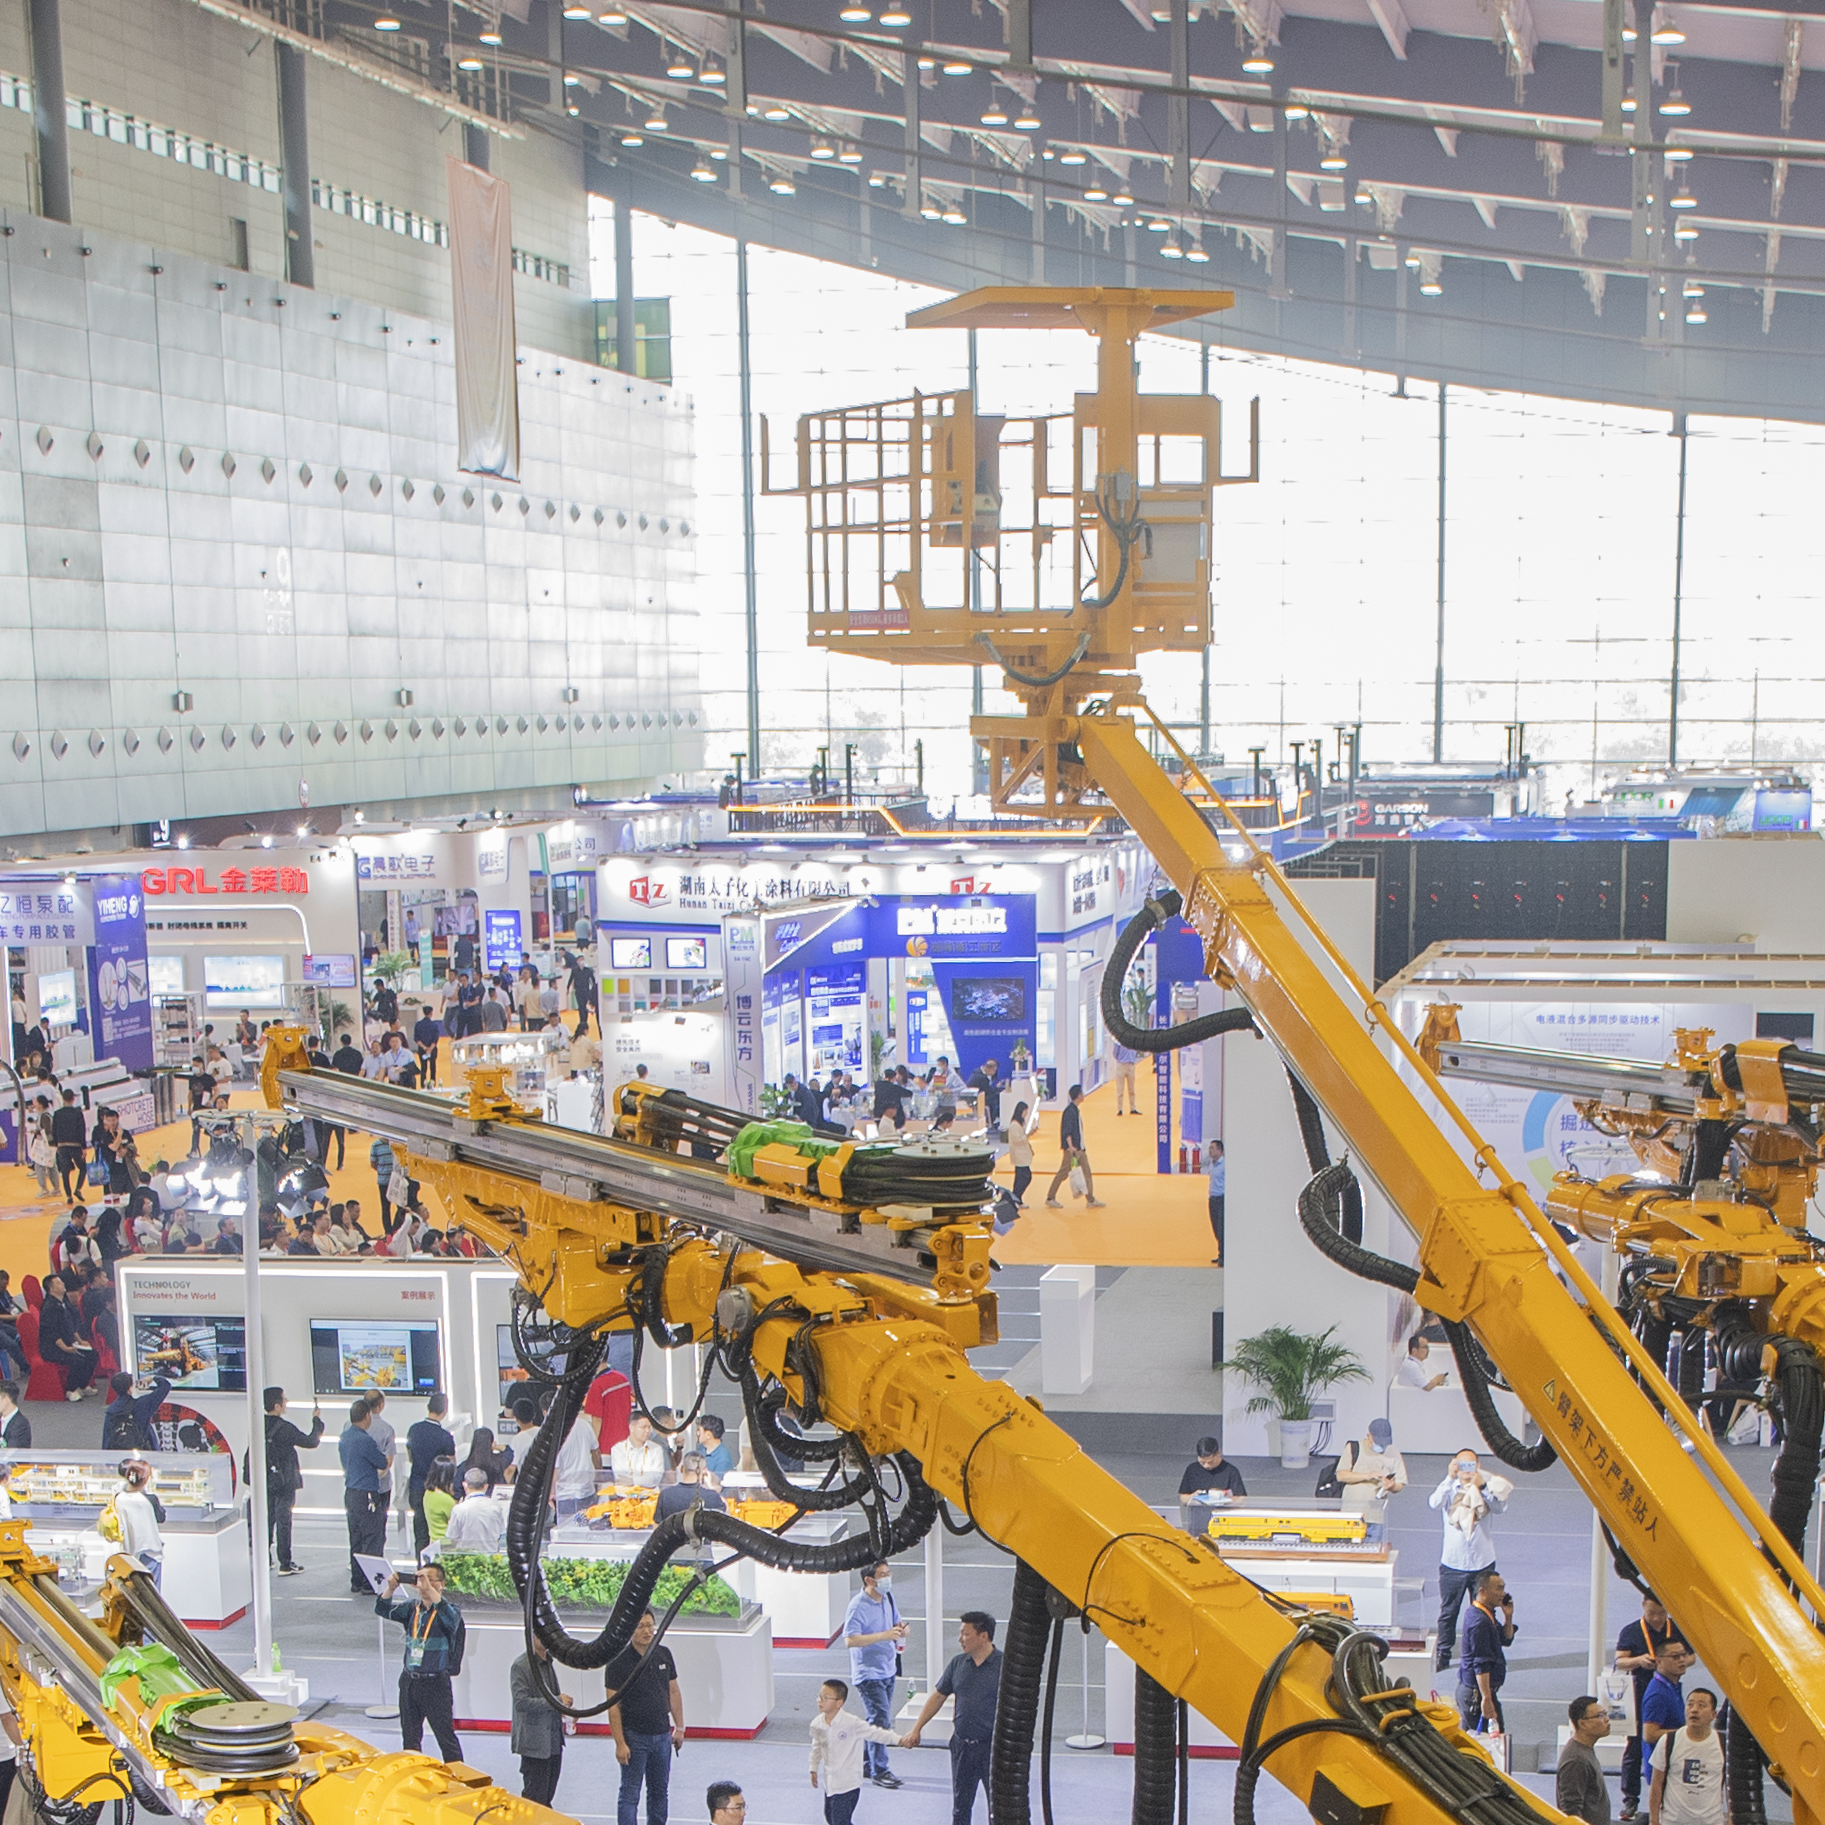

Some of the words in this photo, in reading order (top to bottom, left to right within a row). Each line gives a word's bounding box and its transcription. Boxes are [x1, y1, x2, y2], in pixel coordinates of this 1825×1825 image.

[1374, 803, 1429, 813] GARSON
[142, 867, 218, 895] GRL
[219, 866, 309, 895] 金莱勒
[97, 895, 128, 916] YIHENG
[679, 898, 708, 909] Hunan
[1535, 1014, 1660, 1026] 电液混合多源同步驱动技术
[736, 995, 753, 1062] 博云东方
[117, 1097, 154, 1117] SHOTCRETE
[137, 1110, 155, 1125] HOSE
[134, 1280, 191, 1289] TECHNOLOGY
[133, 1291, 173, 1300] Innovates
[174, 1291, 189, 1300] the
[190, 1291, 217, 1301] World
[1555, 1389, 1661, 1543] 臂架下方严禁站人
